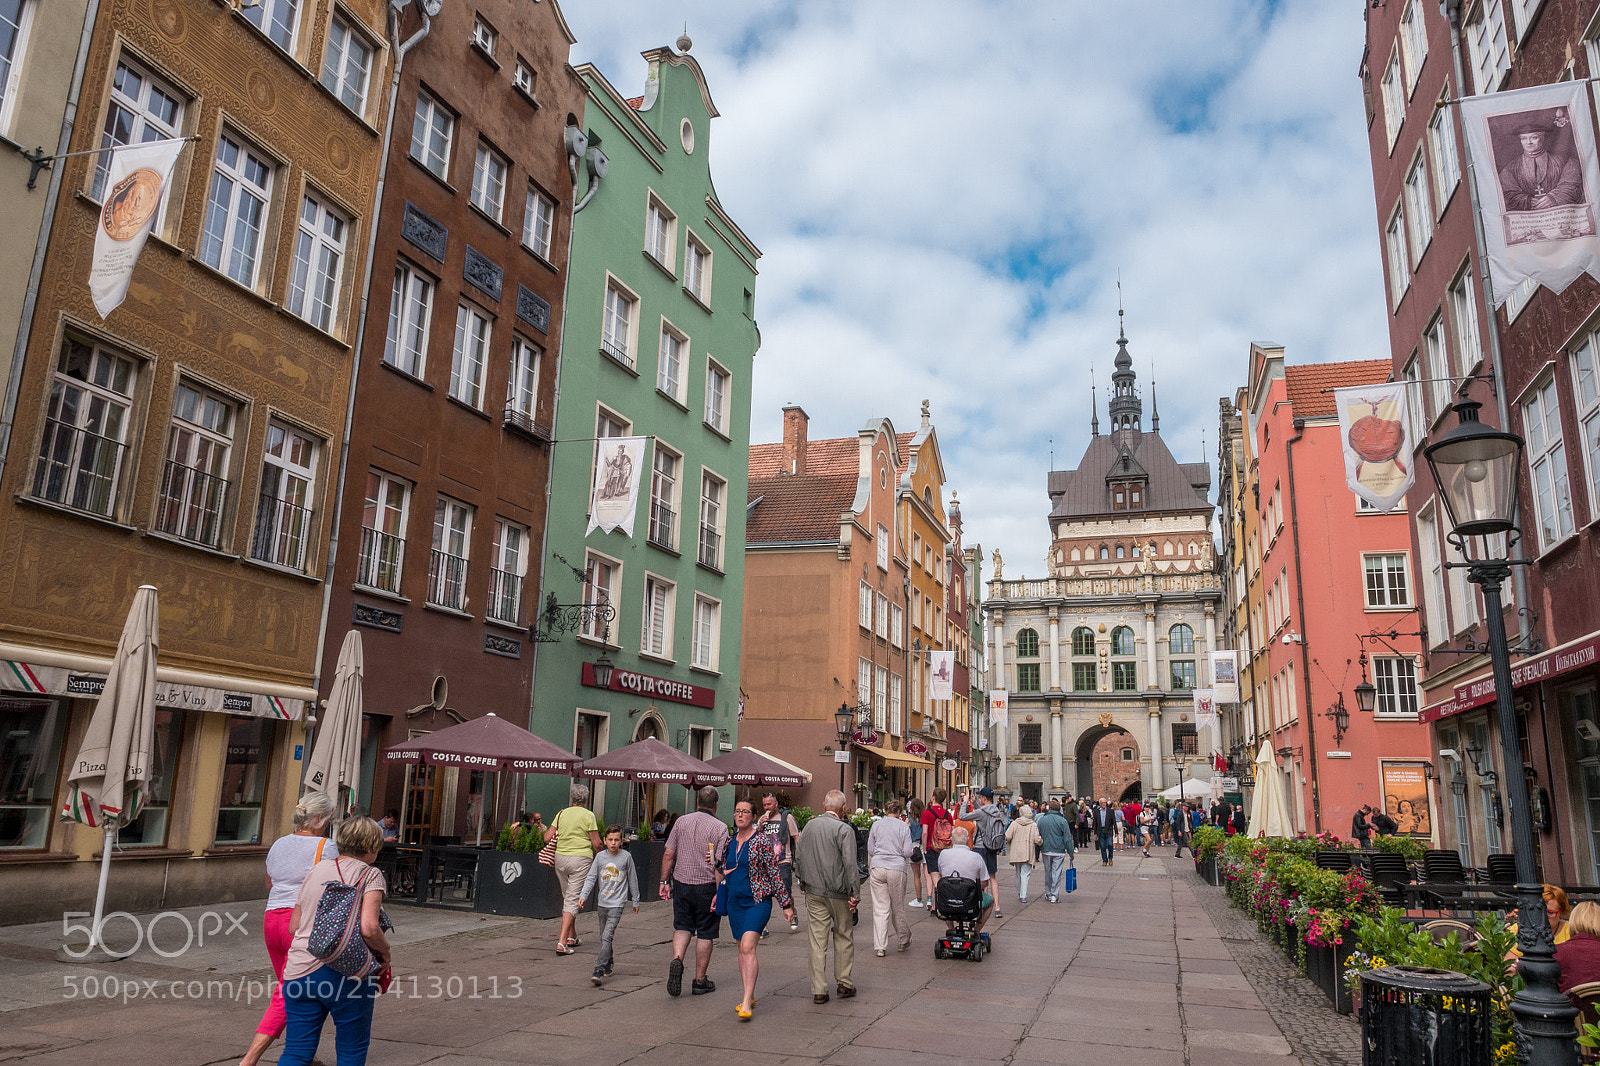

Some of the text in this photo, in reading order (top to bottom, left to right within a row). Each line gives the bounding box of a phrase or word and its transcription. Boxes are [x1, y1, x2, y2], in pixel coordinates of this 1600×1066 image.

[68, 676, 105, 693] Sempre
[620, 671, 693, 699] COSTA COFFEE
[156, 692, 166, 701] za
[182, 690, 206, 706] Vino
[223, 695, 251, 709] Sempre
[387, 751, 420, 760] COSTA COFFEE
[432, 753, 498, 766] COSTA COFFEE
[78, 760, 106, 774] Pizza
[513, 760, 538, 769] COSTA
[540, 761, 567, 770] COFFEE
